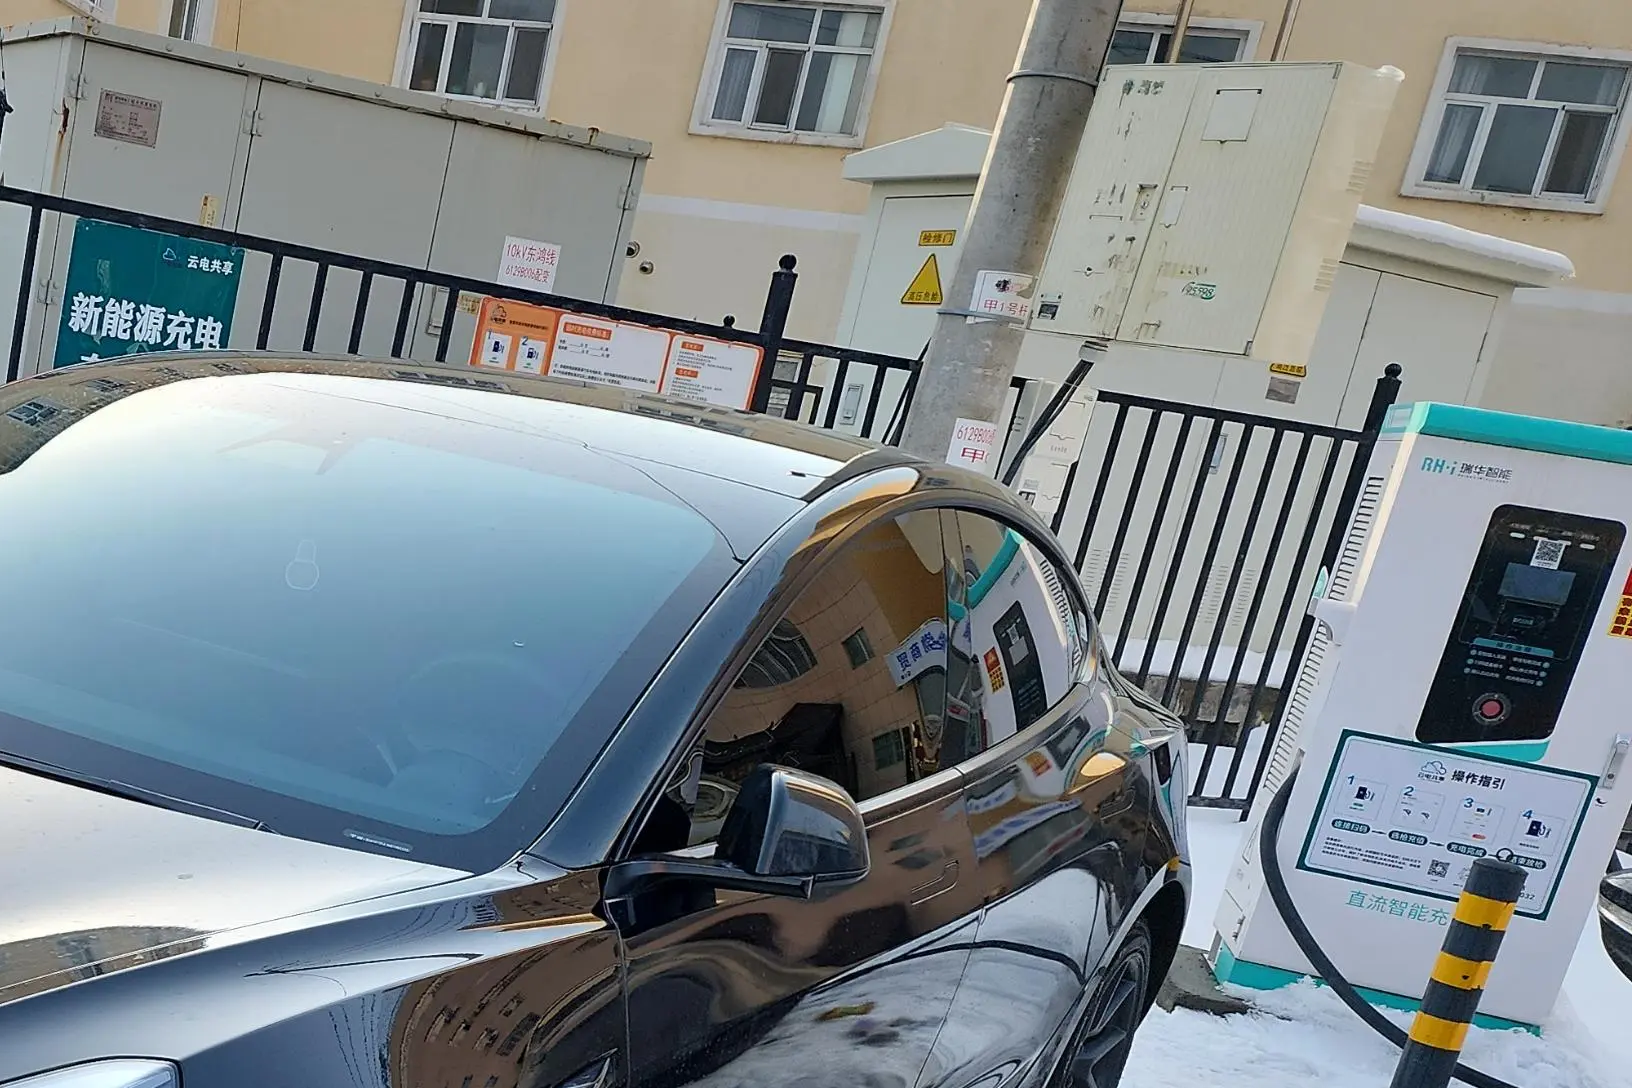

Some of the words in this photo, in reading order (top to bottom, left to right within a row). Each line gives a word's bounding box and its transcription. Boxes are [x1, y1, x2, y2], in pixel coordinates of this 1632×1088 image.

[922, 231, 953, 243] 检修门
[187, 255, 235, 276] 云电共享
[1184, 284, 1215, 298] 95598
[68, 291, 224, 351] 新能源充电
[521, 336, 528, 346] 2
[1459, 461, 1513, 481] 瑞华智能
[1347, 774, 1355, 786] 1
[1451, 769, 1506, 791] 操作指引
[1402, 785, 1415, 798] 2
[1463, 797, 1474, 809] 3
[1522, 809, 1533, 821] 4
